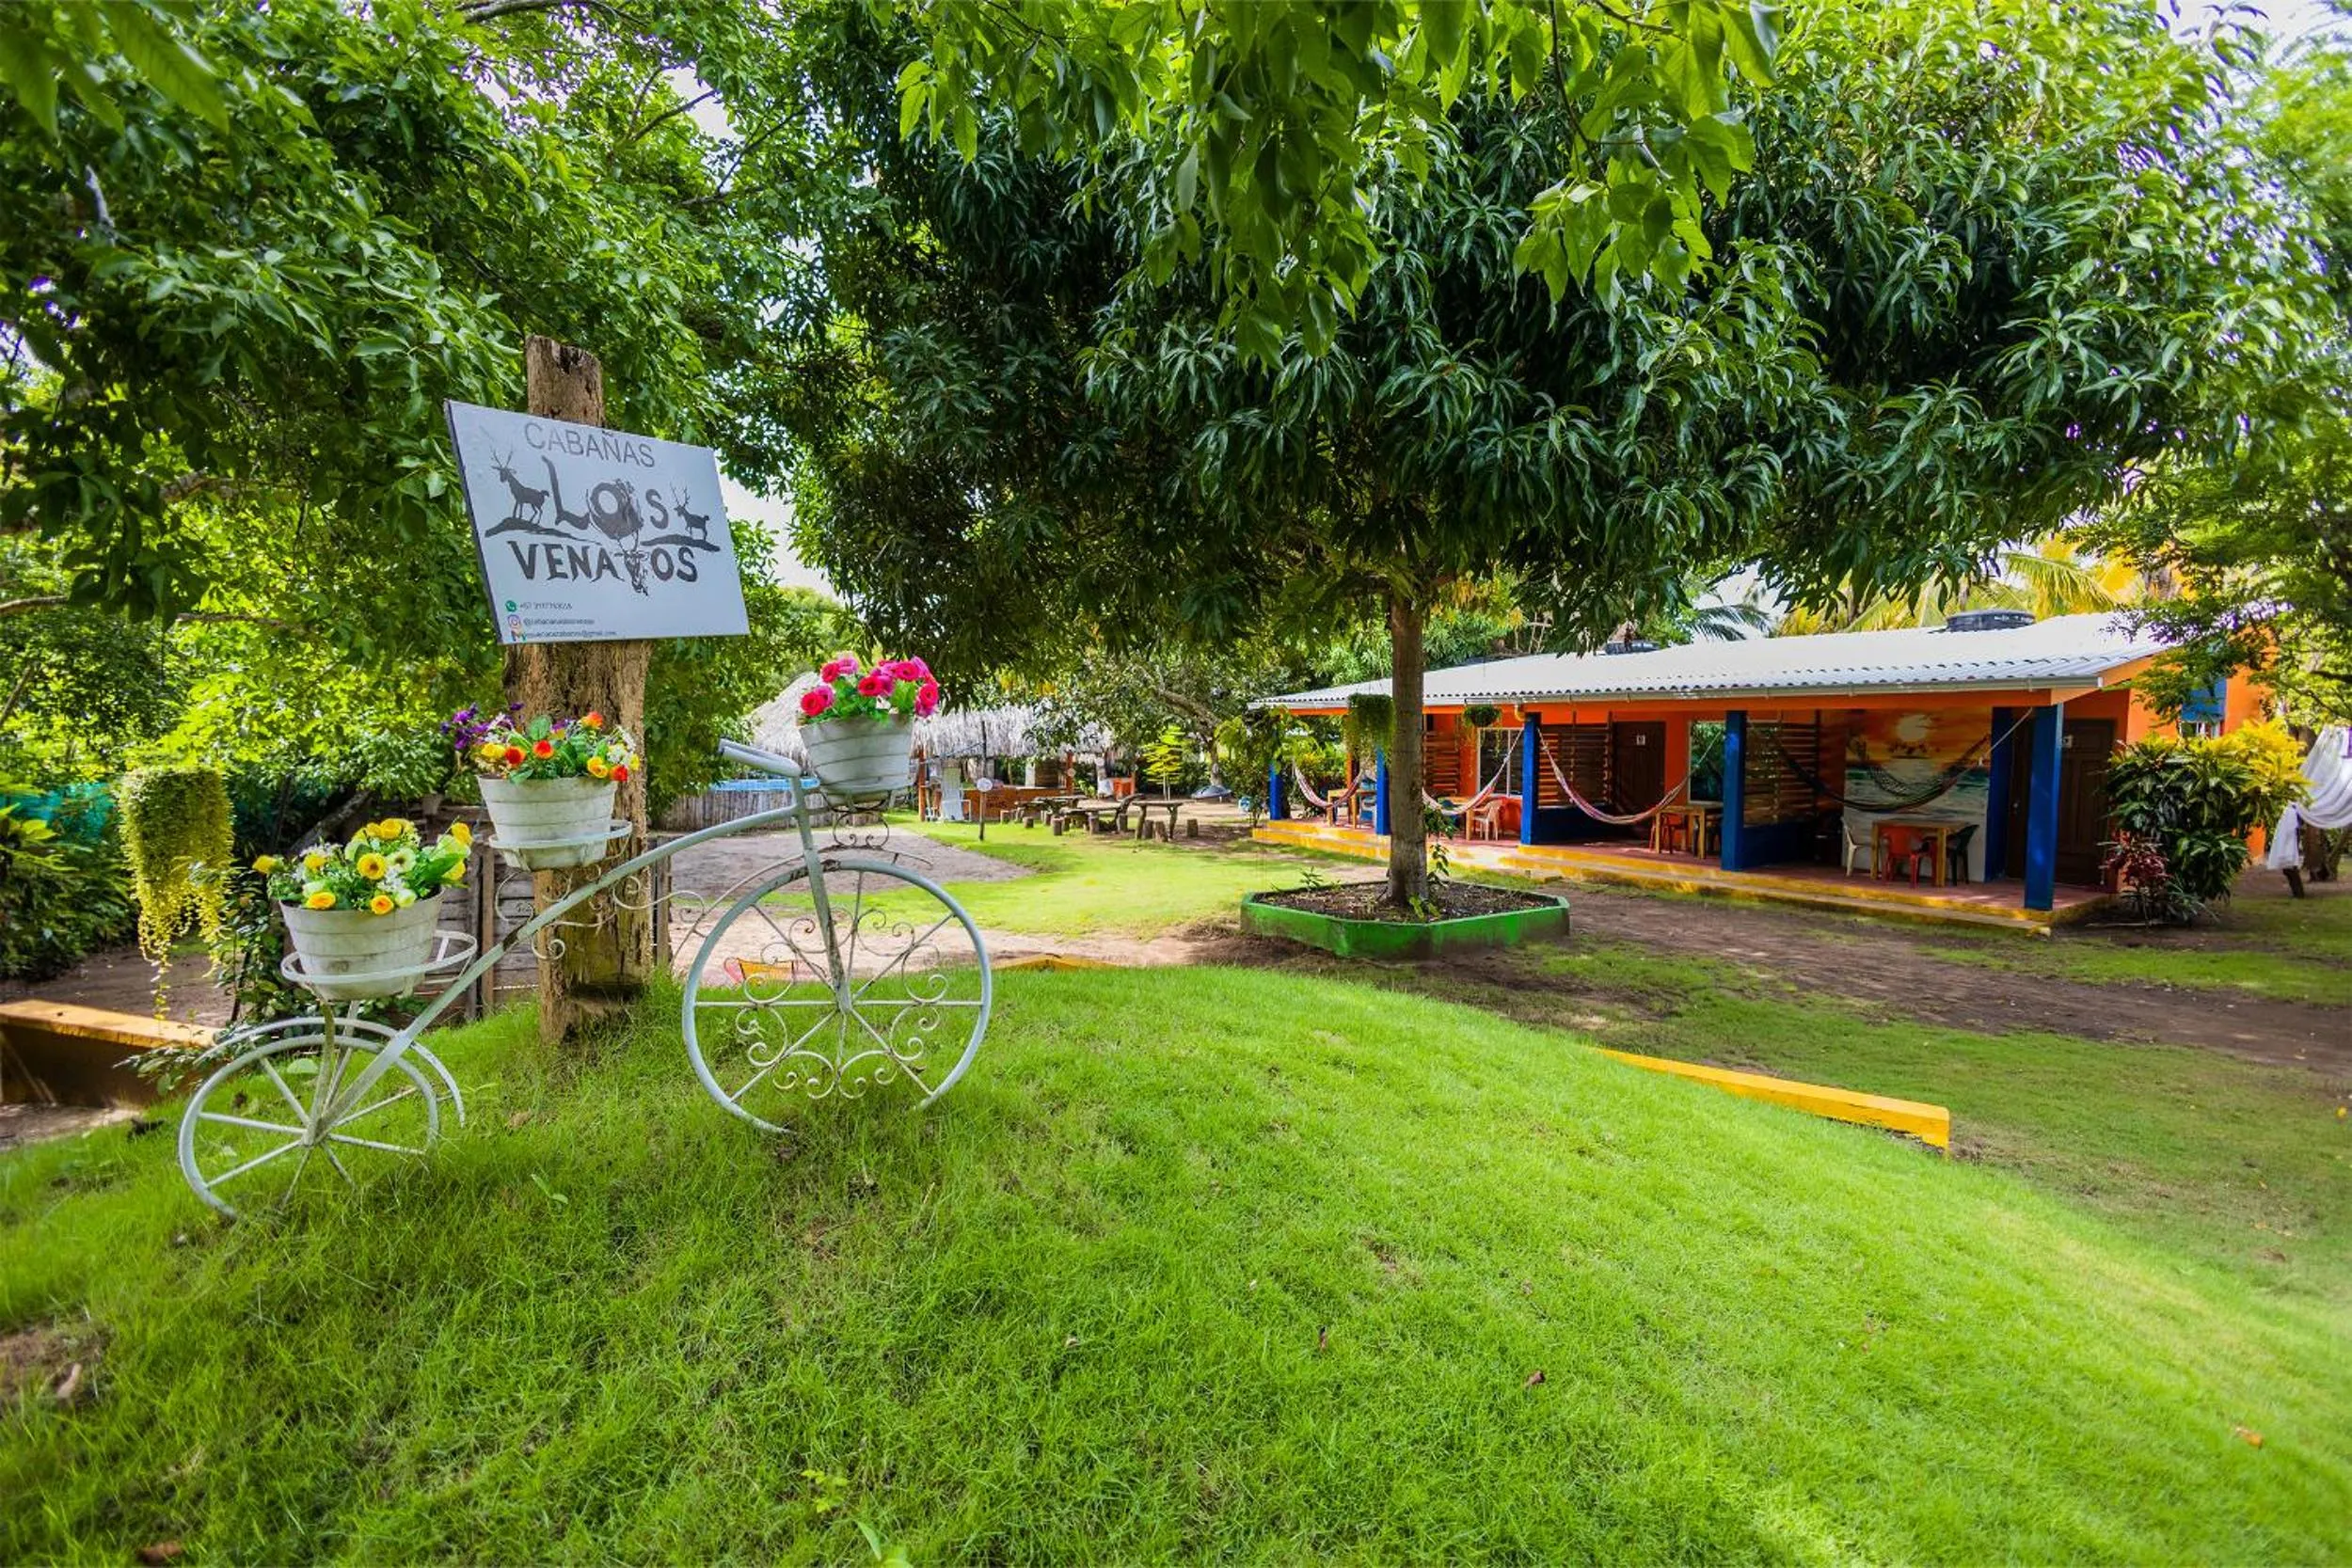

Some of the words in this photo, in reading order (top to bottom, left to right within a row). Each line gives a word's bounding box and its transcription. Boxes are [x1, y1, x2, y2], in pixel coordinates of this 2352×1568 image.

[524, 422, 656, 468] CABAÑAS
[541, 455, 669, 538] LOS
[506, 539, 698, 585] VENAOS
